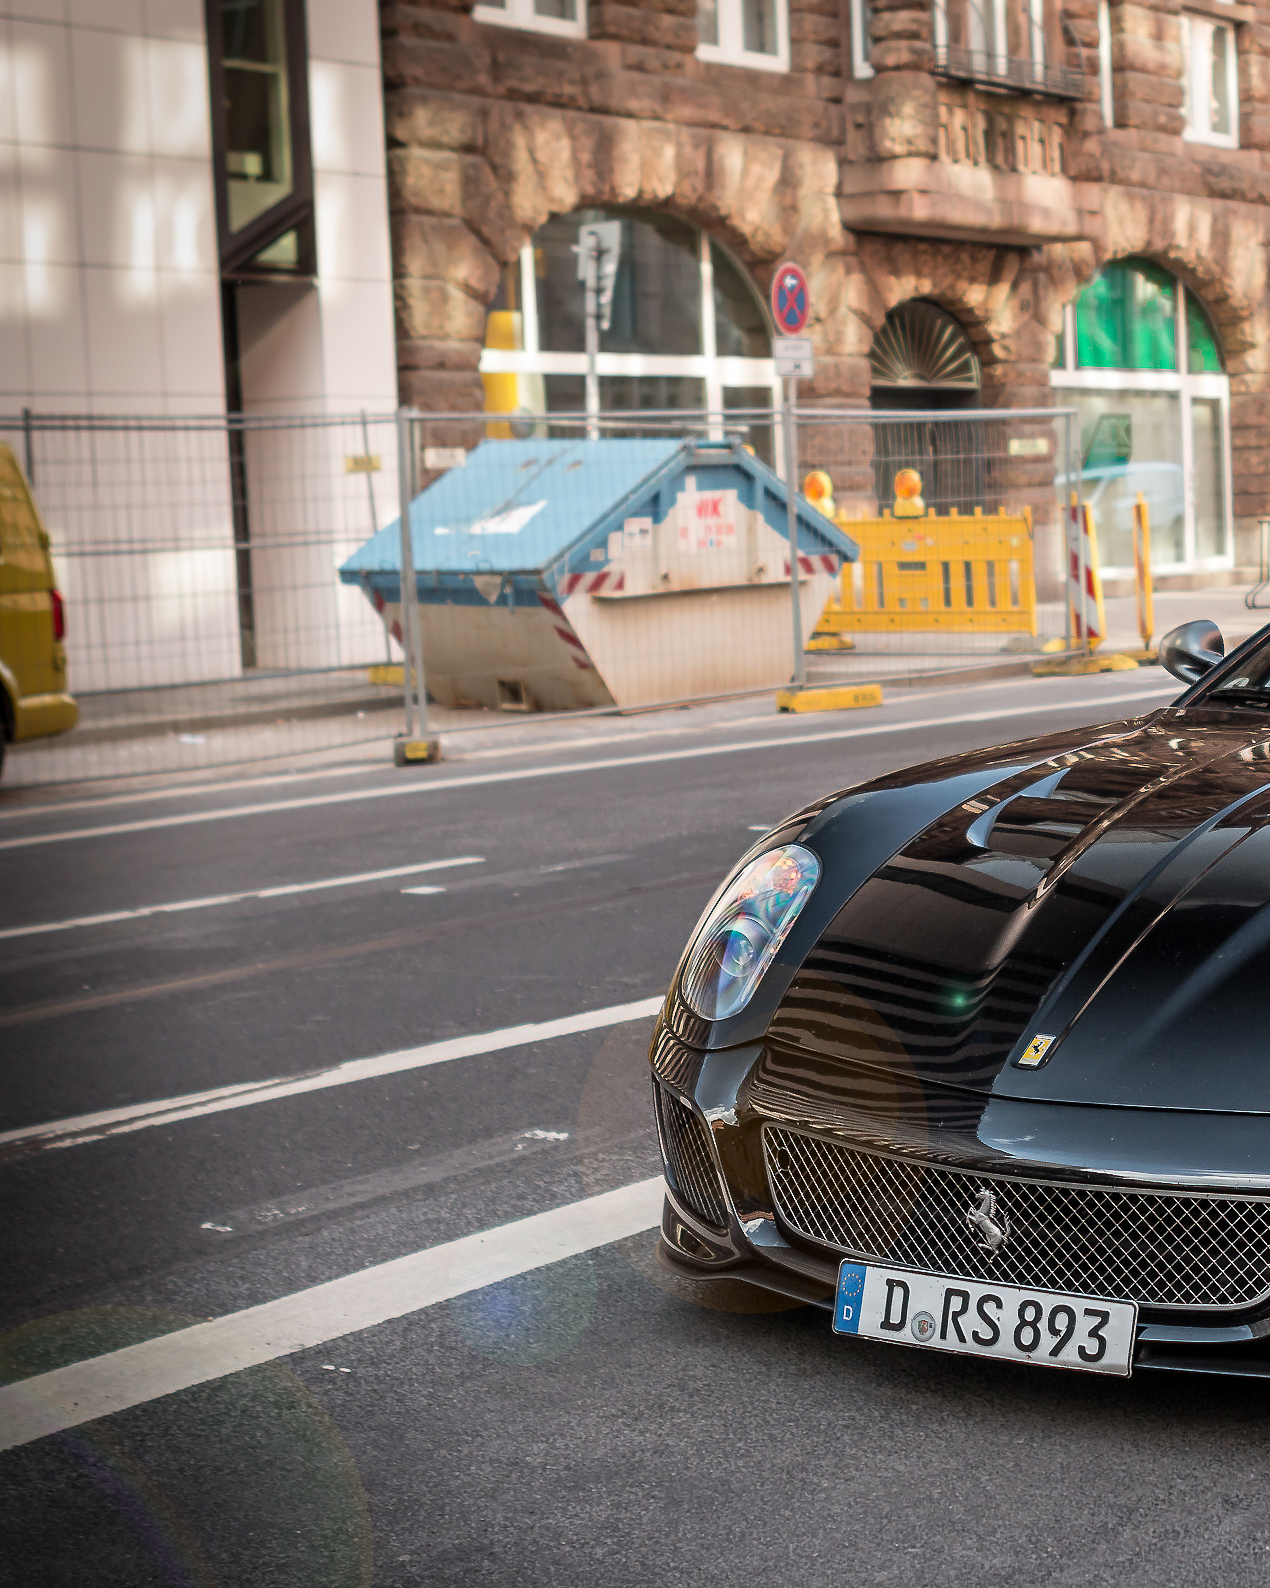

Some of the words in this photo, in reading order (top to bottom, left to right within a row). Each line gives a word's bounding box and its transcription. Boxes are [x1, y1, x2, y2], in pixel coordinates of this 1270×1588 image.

[842, 1305, 853, 1321] D
[880, 1277, 911, 1332] D
[939, 1287, 1004, 1347] RS
[1013, 1299, 1111, 1363] 893
